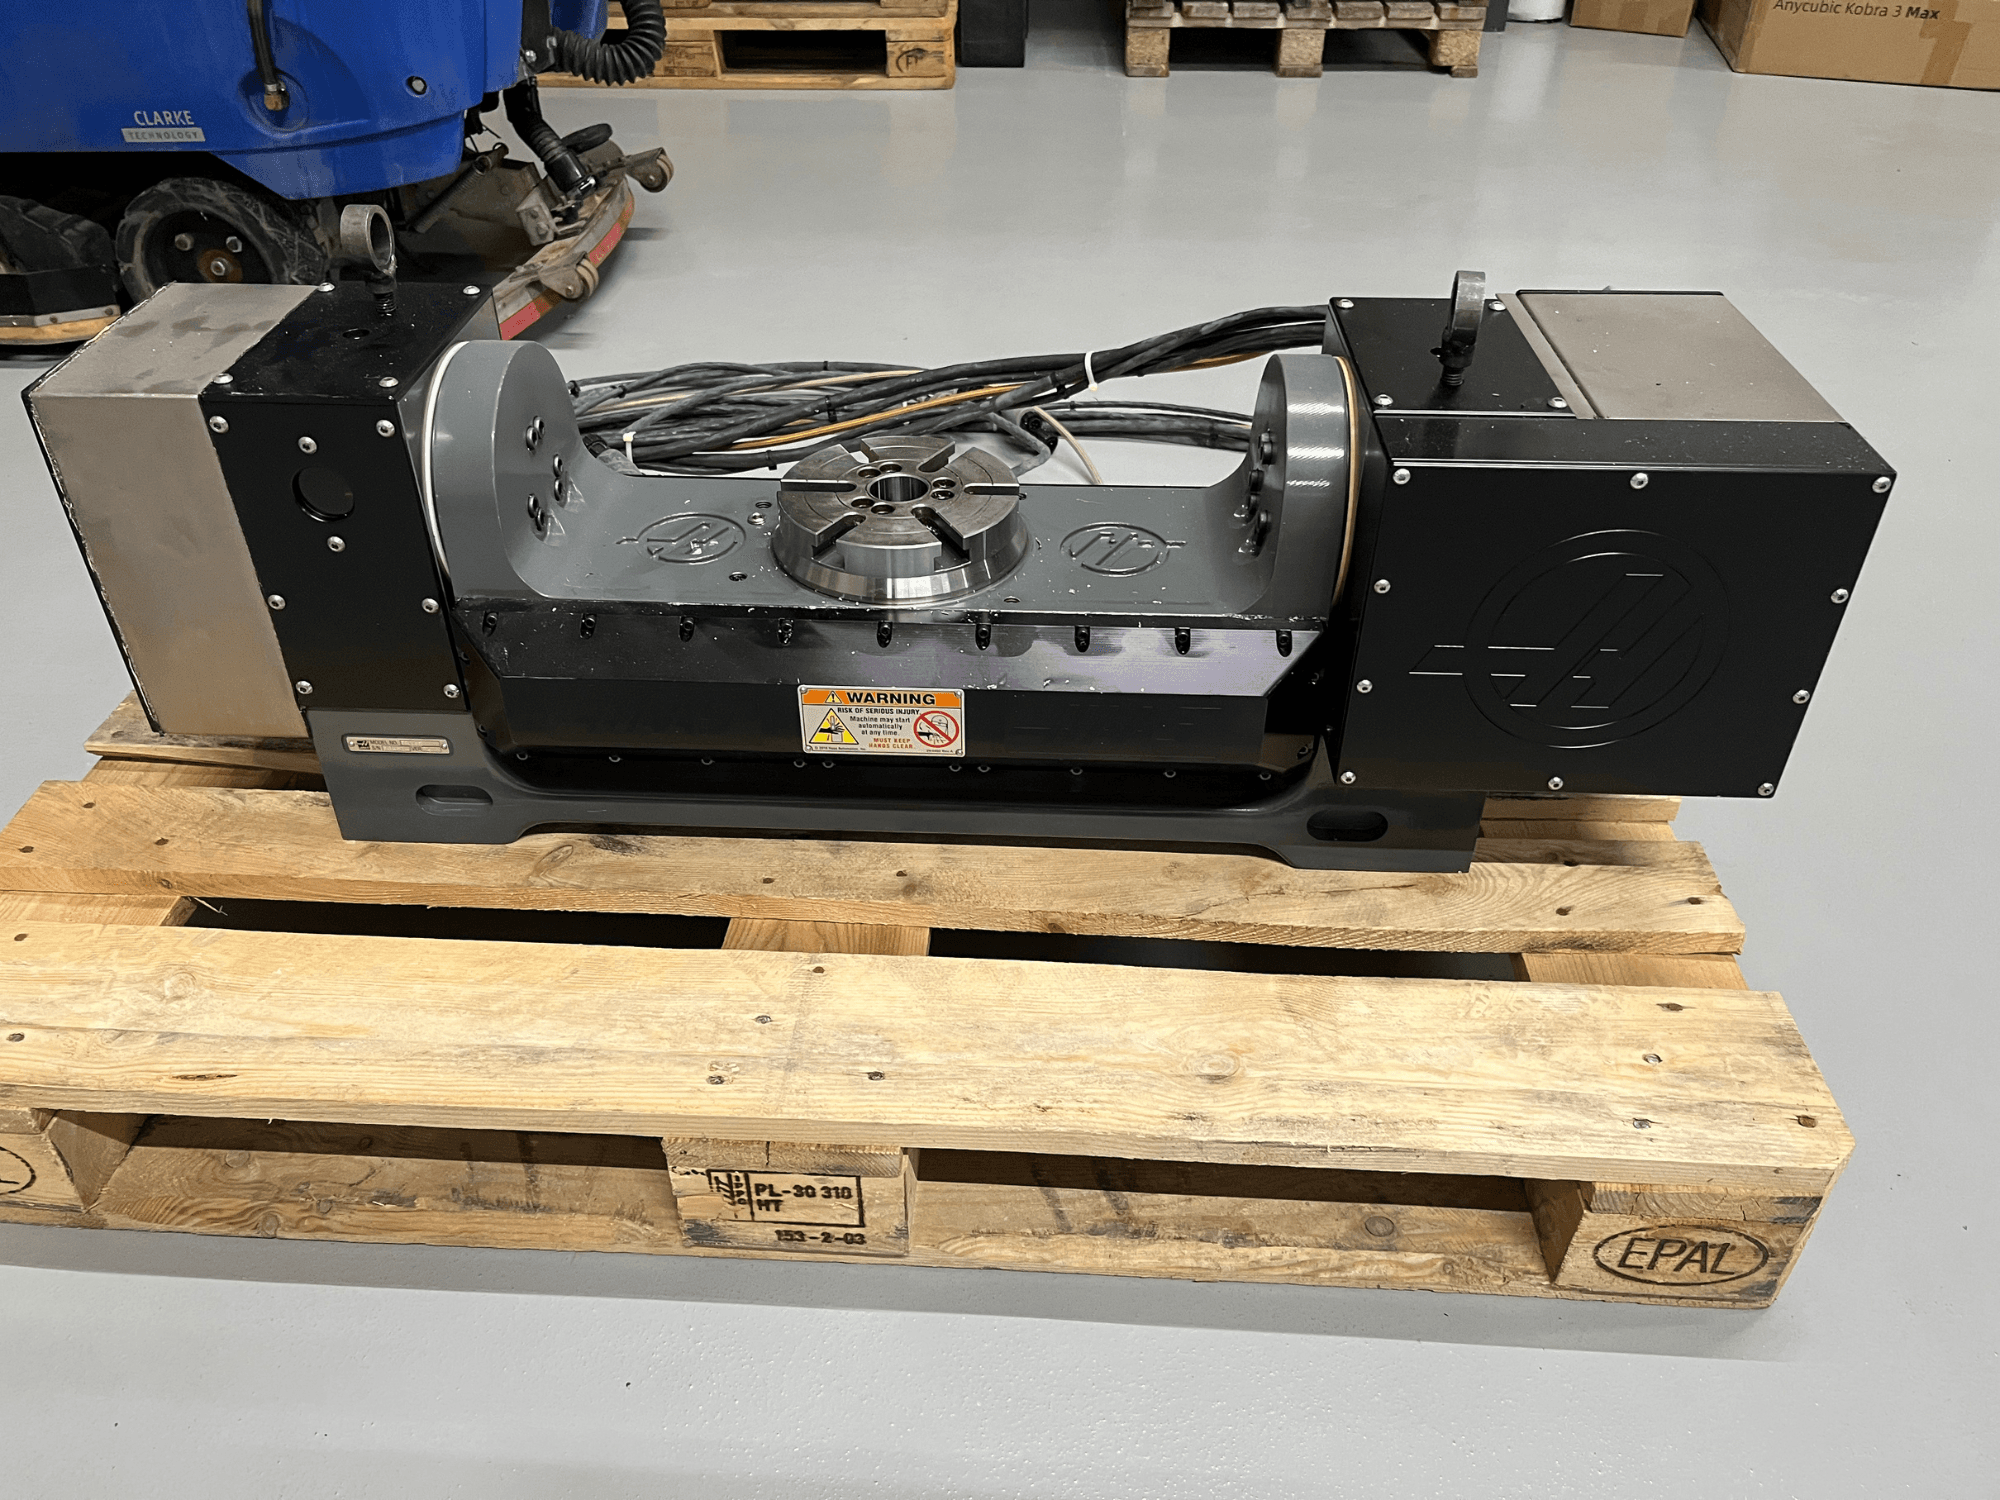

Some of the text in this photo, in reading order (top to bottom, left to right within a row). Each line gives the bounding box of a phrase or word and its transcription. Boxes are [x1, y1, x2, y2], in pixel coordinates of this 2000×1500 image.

[1773, 0, 1941, 20] Anycubic Kobra 3 Max
[134, 110, 195, 126] CLARKE
[128, 131, 198, 140] TECHNOLOGY
[847, 691, 936, 705] WARNING
[754, 1183, 853, 1200] PL-30 310
[756, 1199, 784, 1212] HT
[1618, 1237, 1736, 1275] EPAL
